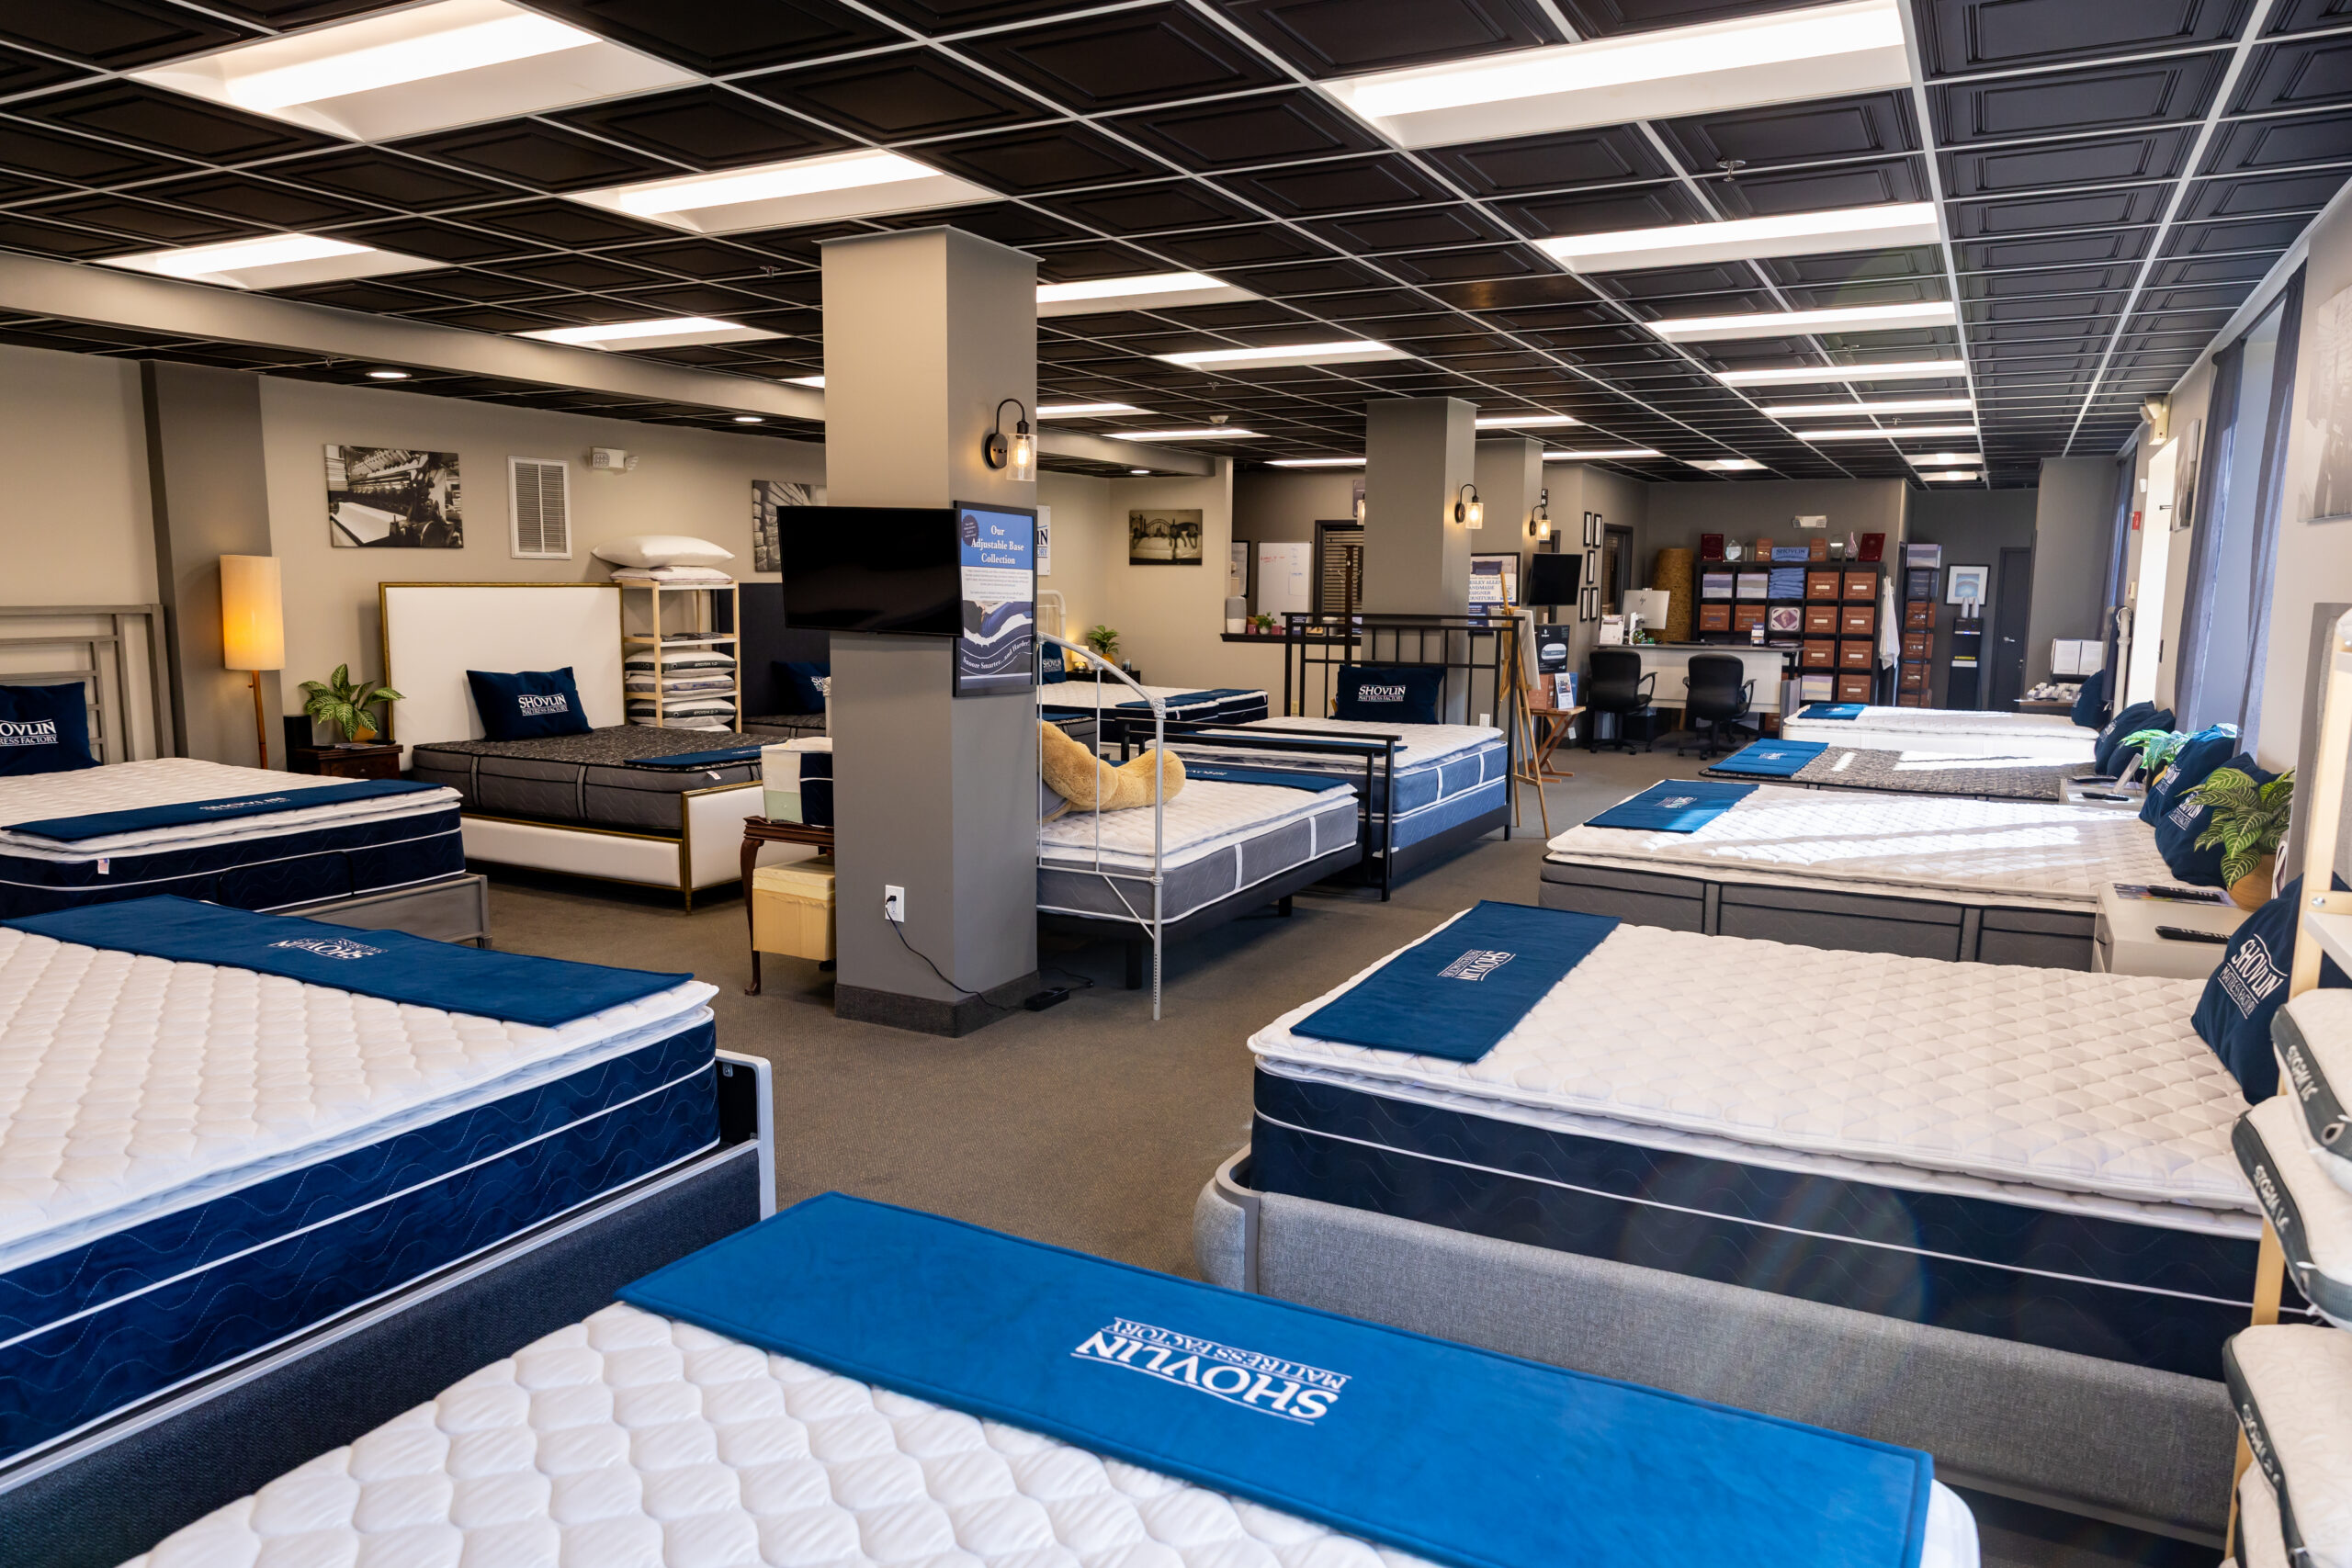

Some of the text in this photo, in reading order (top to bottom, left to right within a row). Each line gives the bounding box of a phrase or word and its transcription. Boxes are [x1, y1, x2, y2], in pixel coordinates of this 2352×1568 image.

[990, 525, 1005, 536] Our
[971, 538, 1024, 551] Adjustable Base
[981, 553, 1015, 564] Collection
[962, 656, 979, 669] Snooze
[1012, 639, 1030, 653] Harder!
[1359, 686, 1406, 695] SHOVLIN
[518, 695, 567, 708] SHOVLIN
[0, 721, 57, 736] OVLIN
[0, 736, 57, 745] RESS FACTORY
[1455, 951, 1510, 981] SHOVLIN
[2231, 939, 2284, 1000] SHOVLIN
[1106, 1320, 1347, 1390] MATTRESS FACTORY
[1075, 1331, 1339, 1419] SHOVLIN
